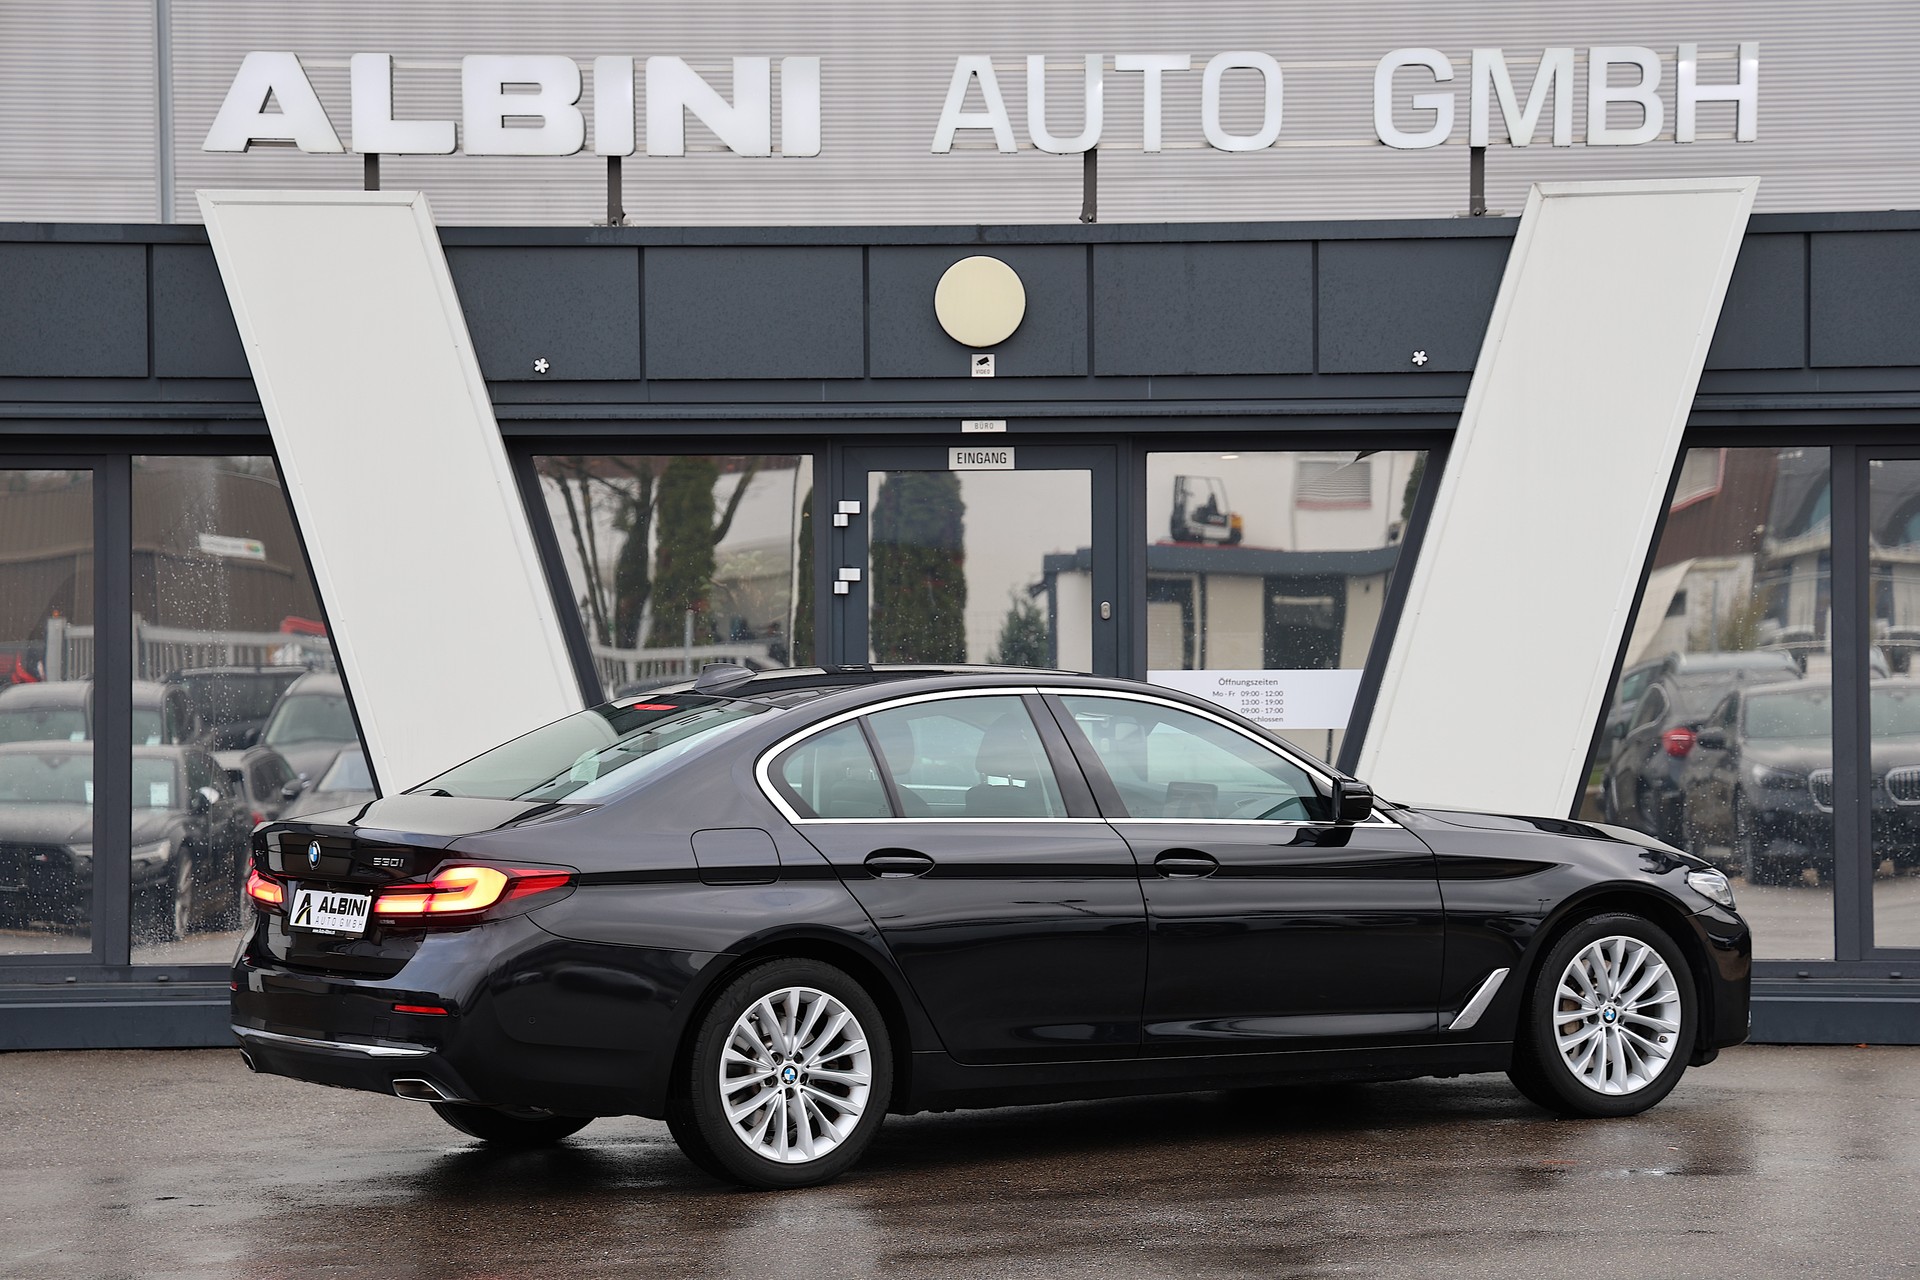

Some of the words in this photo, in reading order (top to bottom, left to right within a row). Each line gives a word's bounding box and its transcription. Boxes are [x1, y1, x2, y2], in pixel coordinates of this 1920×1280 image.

[201, 51, 821, 158] ALBINI
[930, 51, 1283, 154] AUTO
[1372, 41, 1760, 149] GMBH
[974, 422, 994, 430] BÜRO
[957, 452, 1007, 465] EINGANG
[1218, 678, 1278, 687] Öffnungszeiten
[318, 896, 368, 917] ALBINI
[315, 915, 337, 927] AUTO
[339, 918, 363, 929] GMBH
